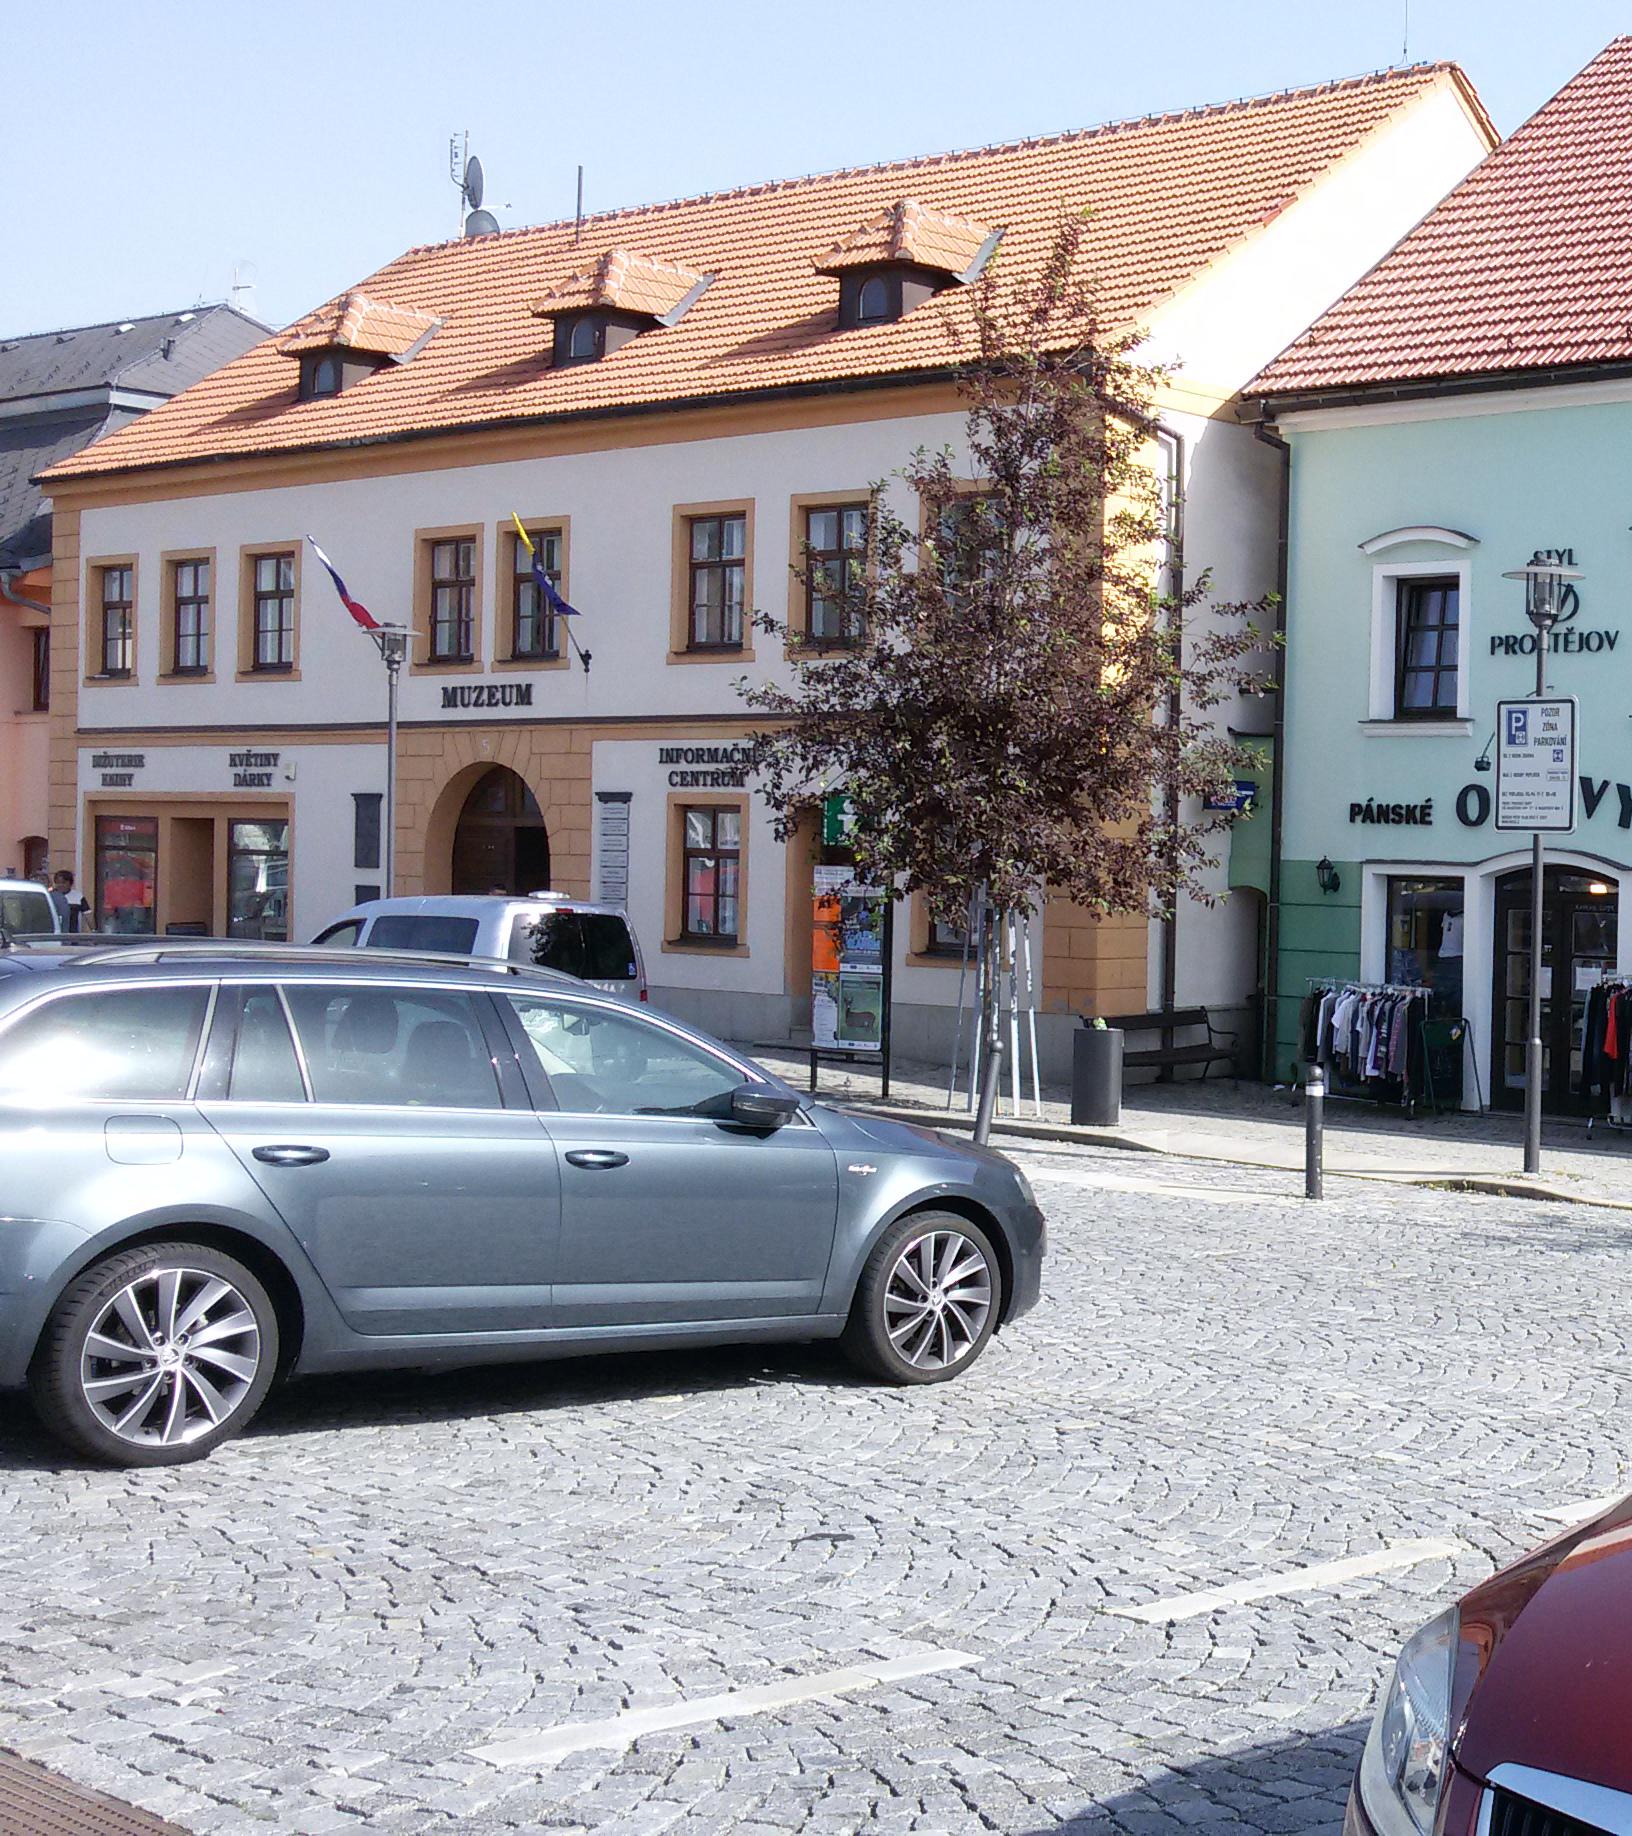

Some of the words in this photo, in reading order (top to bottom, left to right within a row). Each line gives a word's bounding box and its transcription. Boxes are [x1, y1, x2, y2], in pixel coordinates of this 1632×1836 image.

[1490, 626, 1620, 656] PROTĚJOV
[441, 683, 533, 709] MUZEUM
[1533, 735, 1567, 746] PARKOVÁNÍ
[229, 750, 280, 767] KVĚTINY
[233, 769, 272, 787] DÁRKY
[668, 770, 745, 788] CENTRUM
[1350, 797, 1433, 825] PÁNSKÉ
